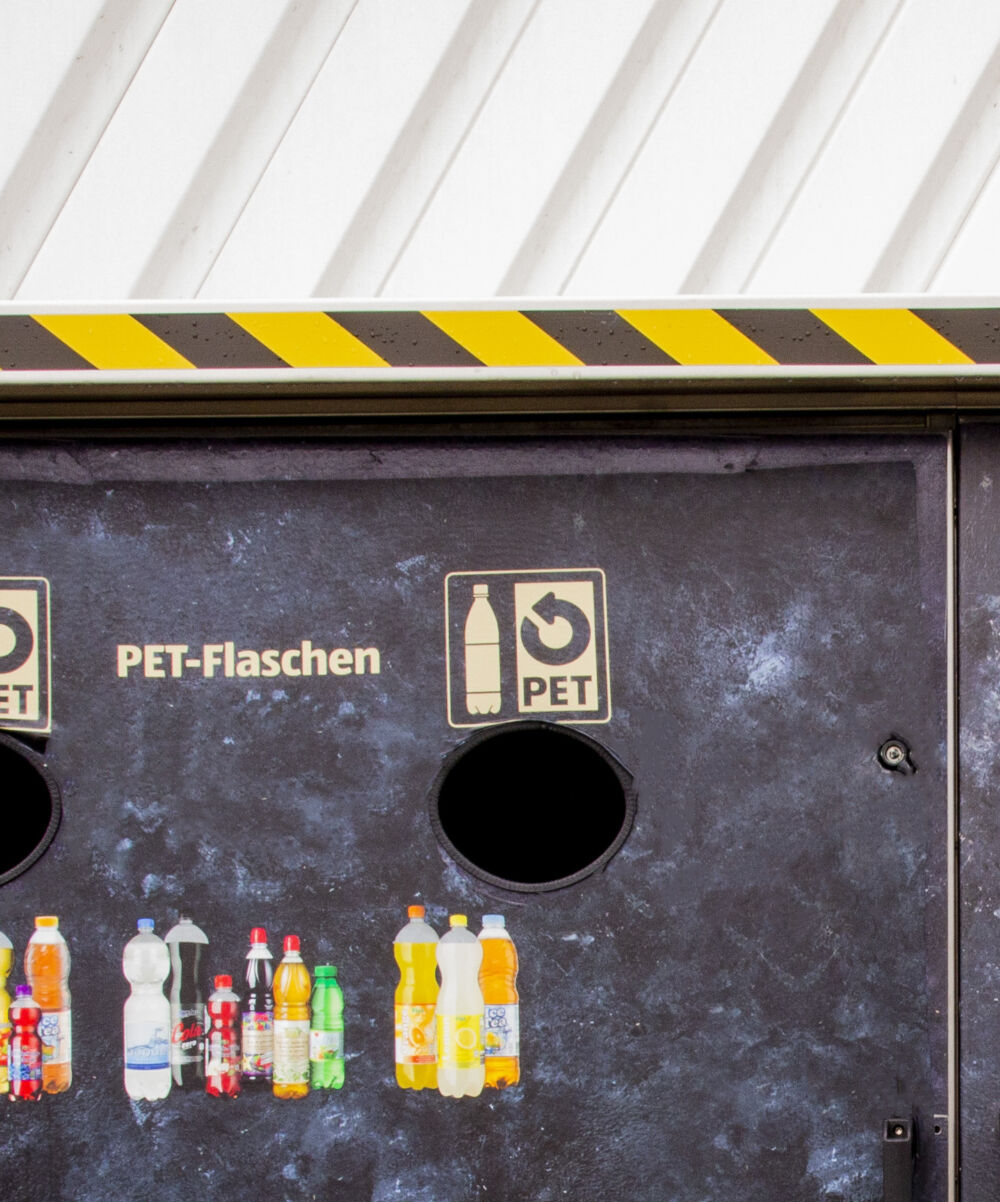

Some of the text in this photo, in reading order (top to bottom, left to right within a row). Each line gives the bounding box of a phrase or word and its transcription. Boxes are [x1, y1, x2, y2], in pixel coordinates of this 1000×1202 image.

[117, 641, 381, 679] PET-Flaschen
[523, 675, 592, 707] PET
[171, 1021, 202, 1044] Cola
